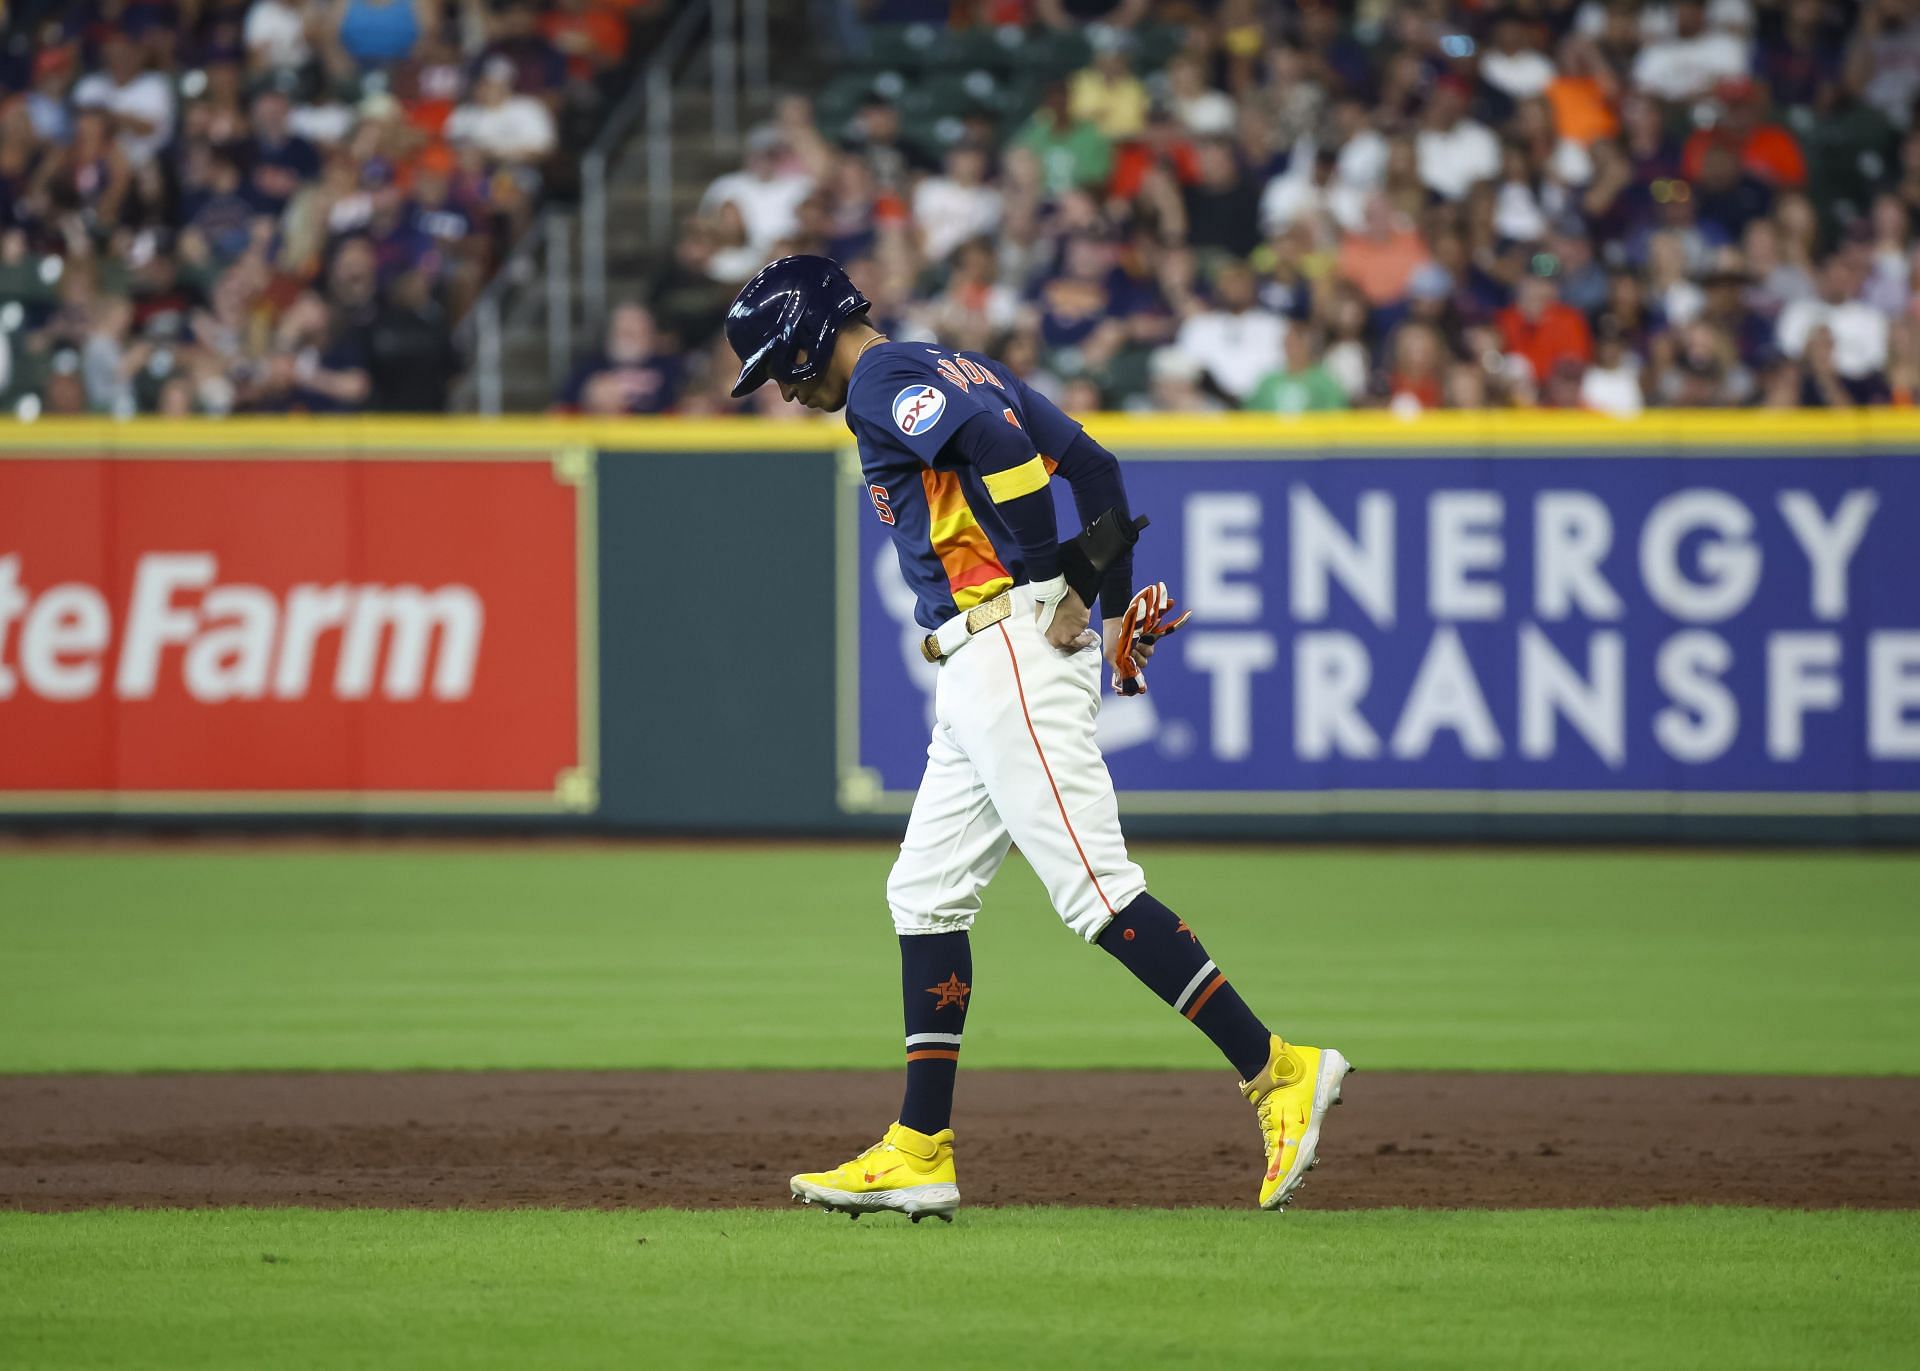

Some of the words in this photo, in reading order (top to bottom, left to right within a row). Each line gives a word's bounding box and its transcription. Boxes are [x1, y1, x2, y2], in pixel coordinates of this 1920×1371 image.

[902, 388, 936, 433] OXY
[1183, 485, 1880, 628] ENERGY
[1184, 624, 1920, 766] TRANSFE
